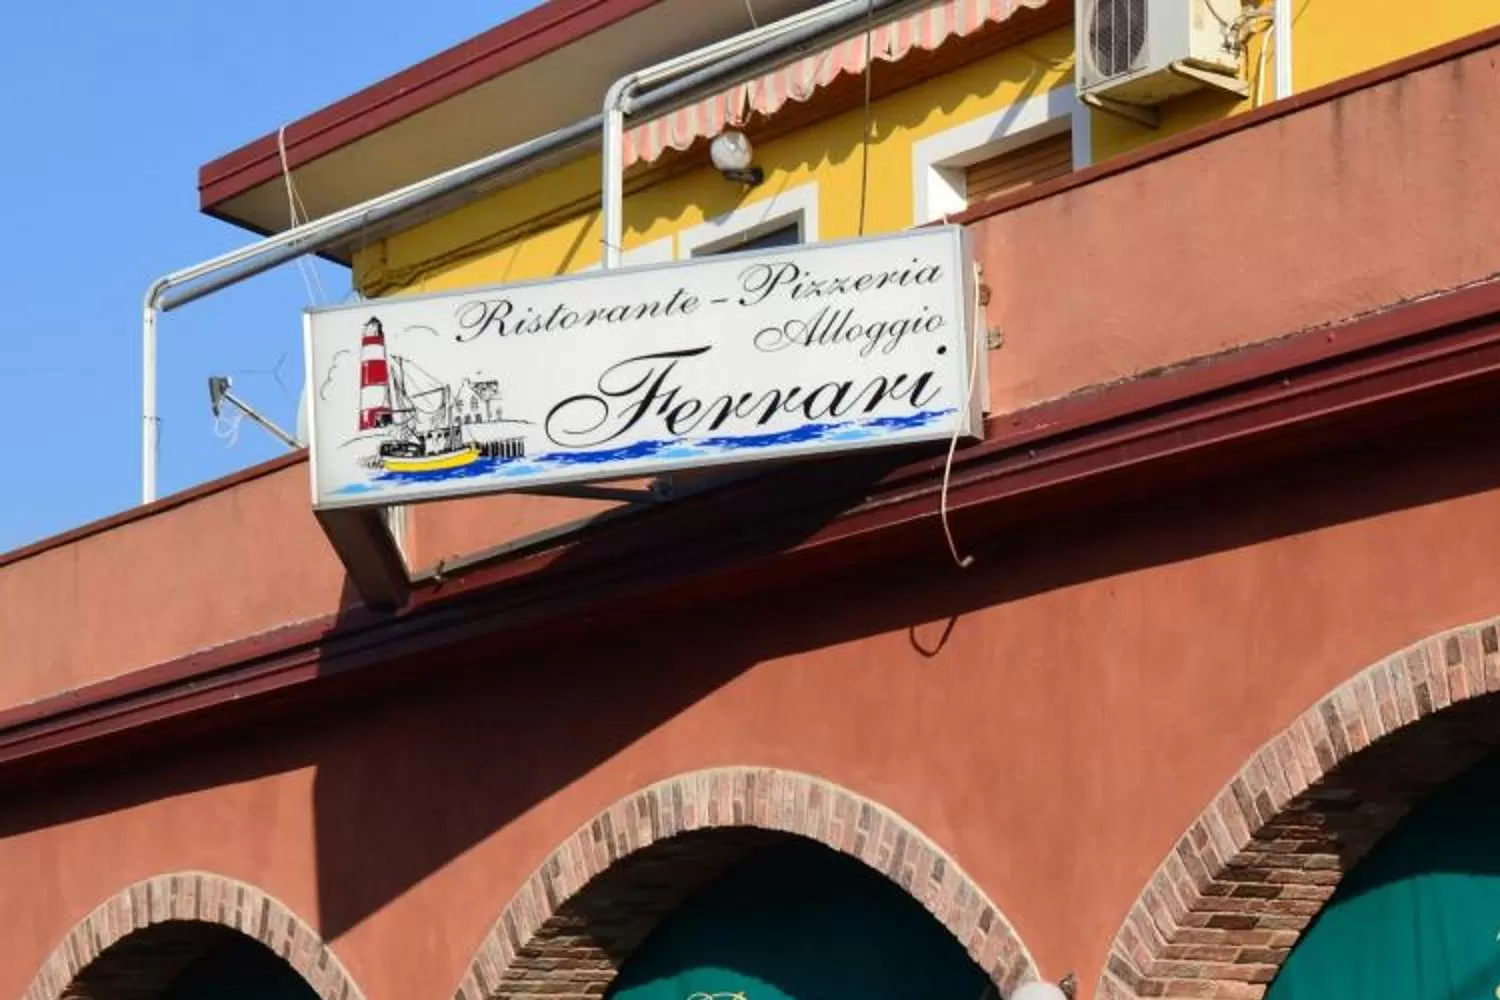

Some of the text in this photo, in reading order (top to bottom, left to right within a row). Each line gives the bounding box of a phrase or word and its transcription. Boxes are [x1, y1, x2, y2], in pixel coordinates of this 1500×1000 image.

[455, 287, 700, 343] Ristorante
[737, 256, 942, 308] Pizzeria
[753, 304, 947, 359] Alloggio
[544, 344, 948, 448] Ferrari
